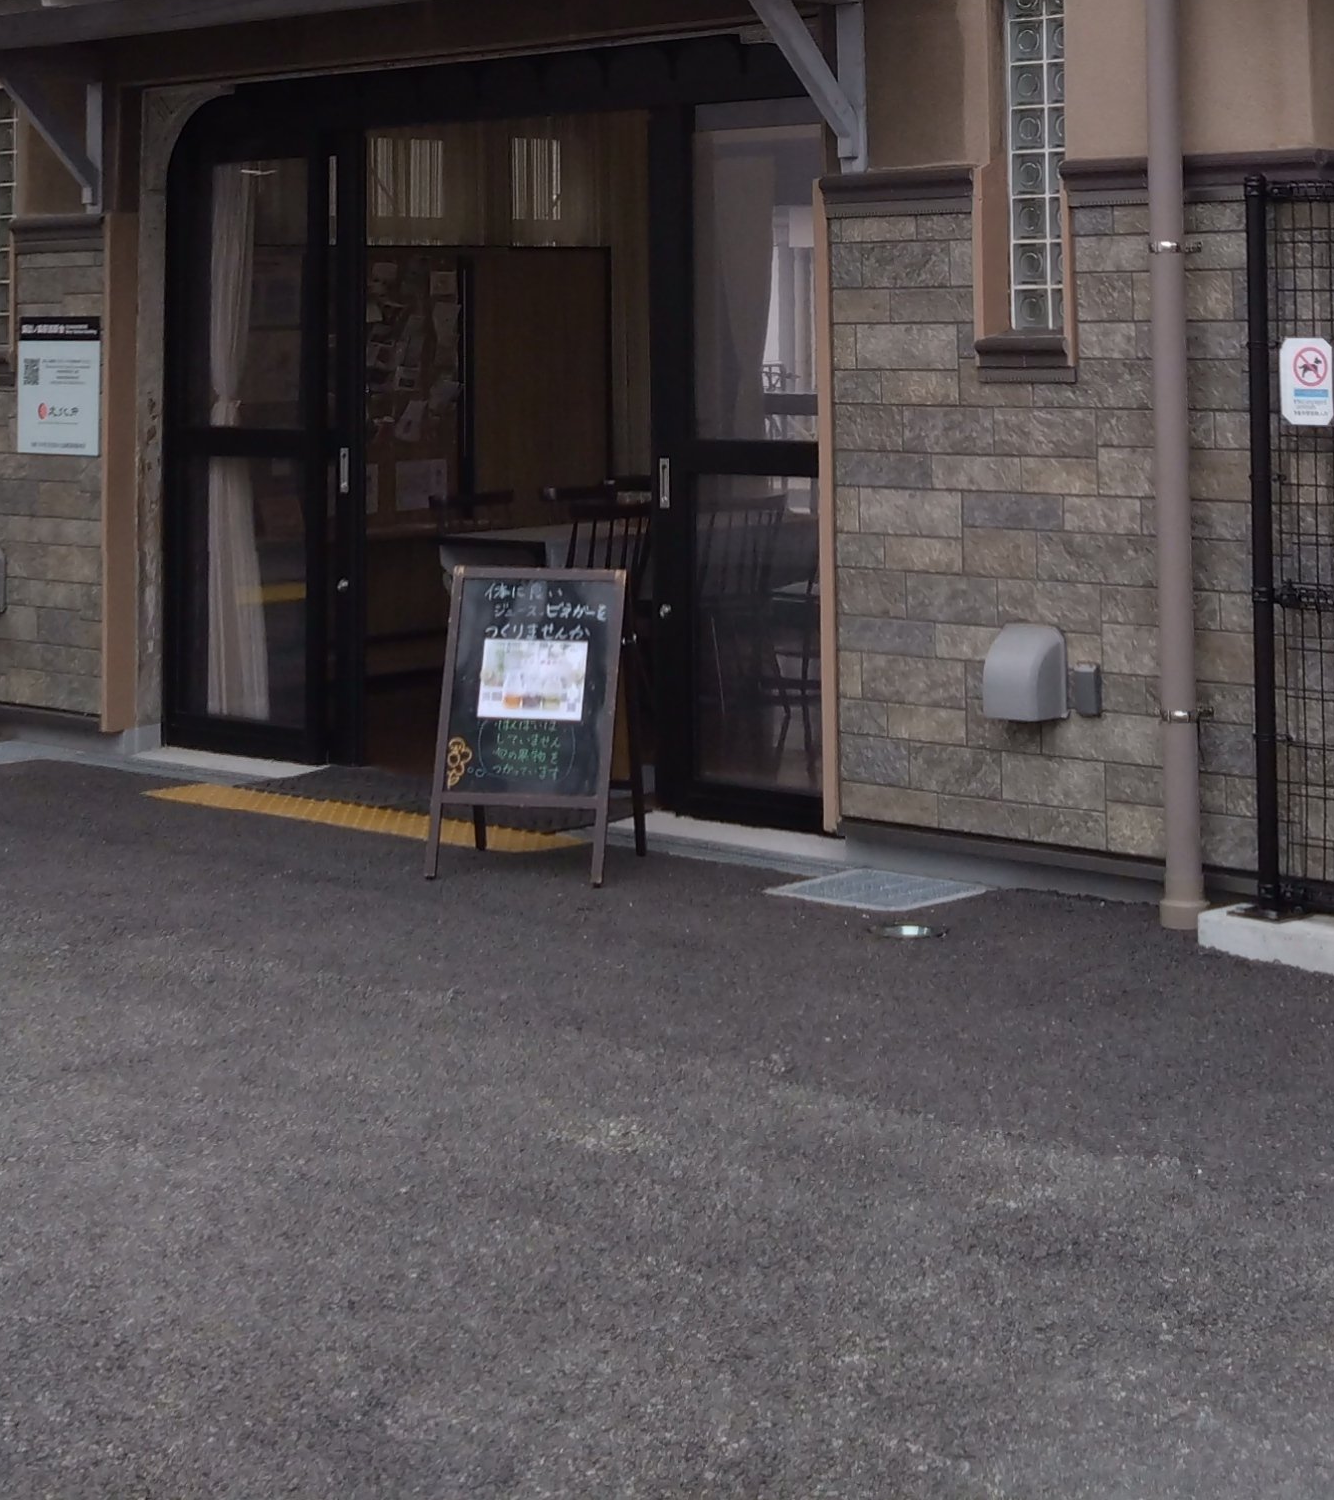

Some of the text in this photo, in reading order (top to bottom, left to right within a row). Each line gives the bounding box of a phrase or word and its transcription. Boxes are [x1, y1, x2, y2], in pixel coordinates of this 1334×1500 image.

[485, 622, 591, 640] つくりませんか
